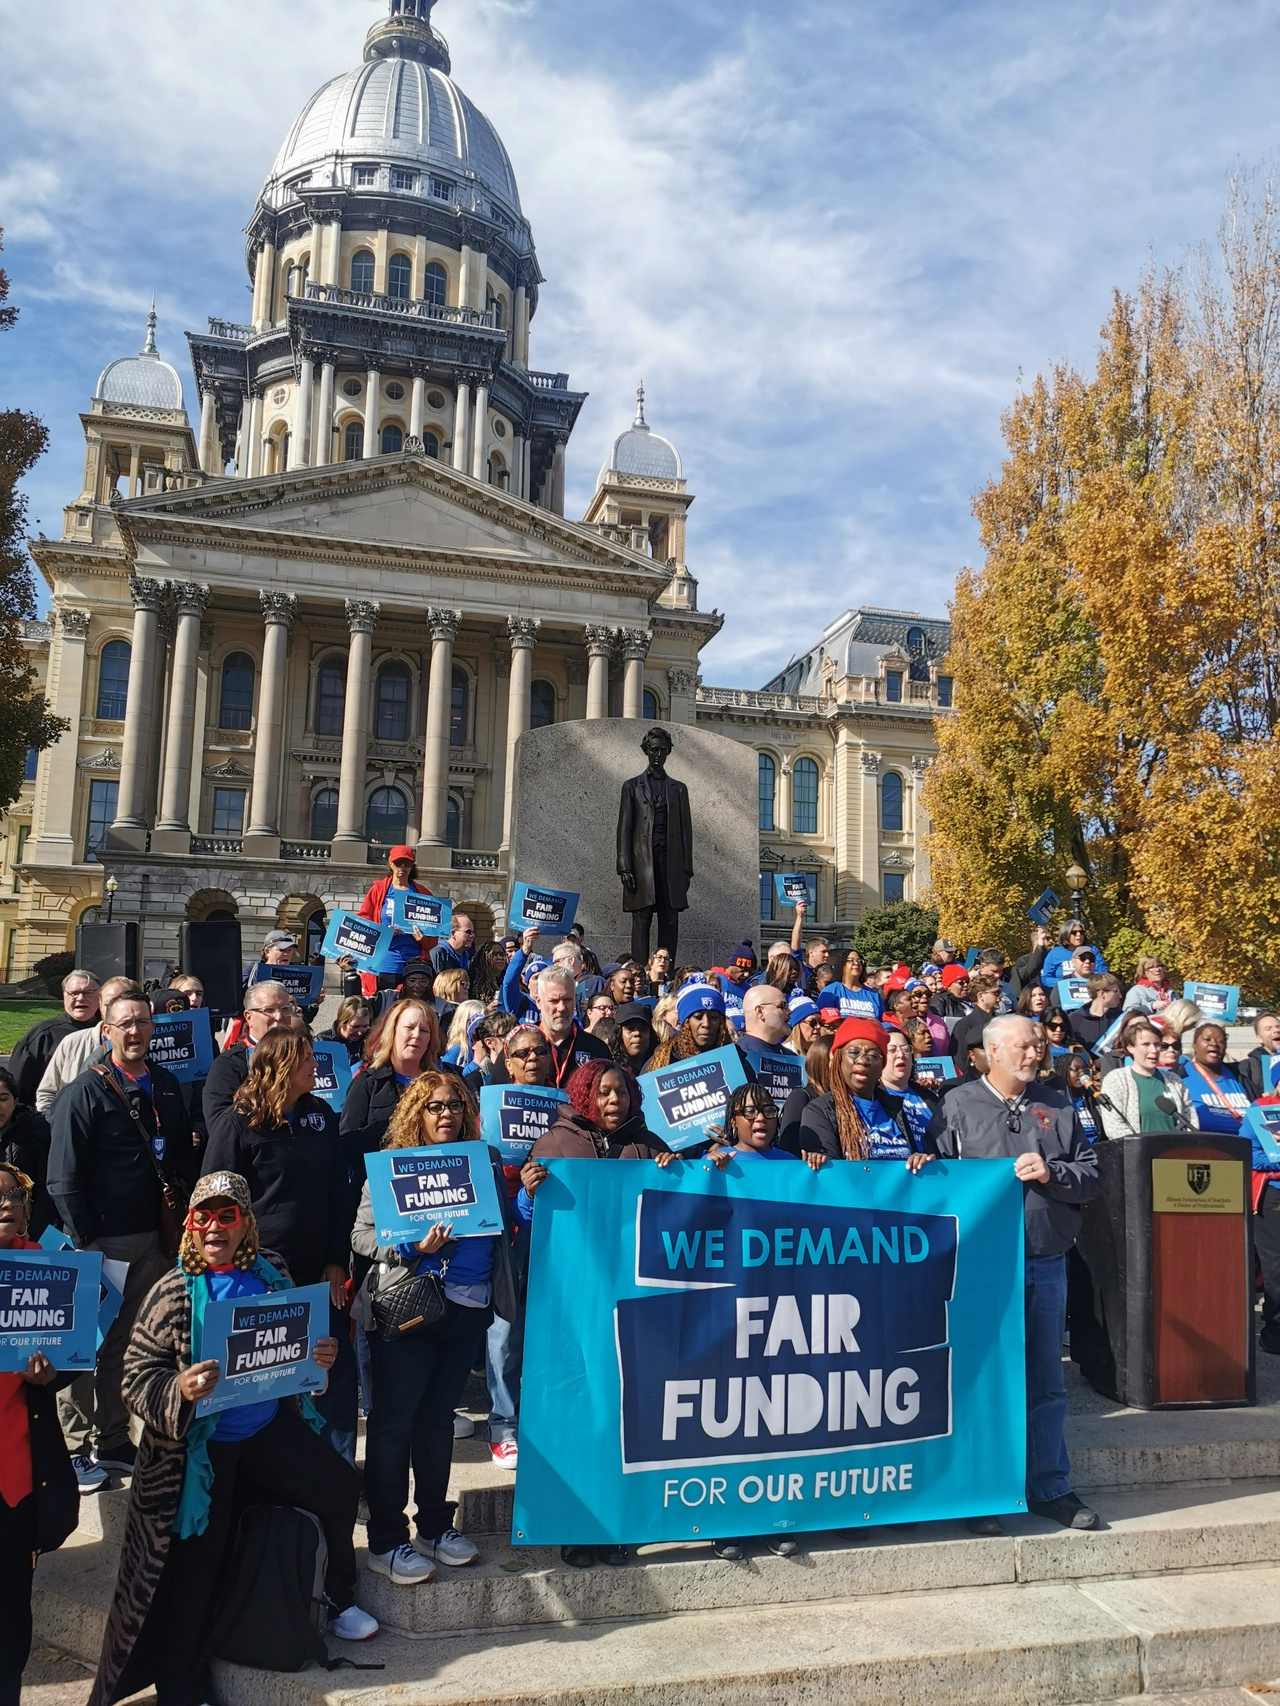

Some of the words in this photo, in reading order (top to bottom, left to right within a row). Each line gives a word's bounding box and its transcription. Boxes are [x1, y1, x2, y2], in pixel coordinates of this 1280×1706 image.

[417, 900, 440, 908] DEMAND
[536, 902, 553, 912] FAIR
[538, 896, 564, 904] DEMAND
[408, 912, 438, 922] FUNDING
[416, 906, 432, 914] FAIR
[526, 909, 560, 920] FUNDING
[344, 921, 354, 929] WE
[354, 924, 378, 936] DEMAND
[350, 930, 366, 942] FAIR
[340, 936, 372, 954] FUNDING
[736, 958, 752, 968] CTU
[840, 998, 874, 1012] ILLINOIS
[1196, 1000, 1224, 1010] FUNDING
[1204, 994, 1218, 1002] FAIR
[152, 1024, 188, 1034] EMAND
[150, 1036, 176, 1050] FAIR
[149, 1048, 188, 1062] NDING
[773, 1064, 798, 1073] DEMAND
[662, 1078, 676, 1090] WE
[677, 1064, 716, 1084] DEMAND
[772, 1074, 788, 1086] FAIR
[680, 1082, 708, 1102] FAIR
[764, 1086, 792, 1098] UNDIN
[508, 1097, 522, 1106] WE
[671, 1092, 726, 1120] FUNDING
[523, 1110, 549, 1126] FAIR
[678, 1122, 692, 1132] FOR
[692, 1116, 708, 1126] OUR
[708, 1110, 726, 1122] FUTUR
[509, 1124, 550, 1138] FUNDI
[398, 1163, 414, 1174] WE
[418, 1158, 463, 1171] DEMAND
[418, 1173, 450, 1190] FAIR
[1188, 1170, 1210, 1182] IFT
[210, 1175, 232, 1193] NY
[404, 1188, 468, 1208] FUNDING
[410, 1214, 425, 1222] FOR
[426, 1212, 442, 1220] OUR
[444, 1208, 470, 1218] FUTURE
[662, 1230, 724, 1270] WE
[742, 1226, 930, 1268] DEMAND
[16, 1270, 70, 1281] DEMAND
[10, 1288, 50, 1306] FAIR
[0, 1310, 66, 1328] UNDING
[238, 1314, 256, 1328] WE
[258, 1306, 304, 1325] DEMAND
[736, 1294, 862, 1359] FAIR
[10, 1338, 30, 1346] OUR
[32, 1336, 62, 1346] FUTURE
[255, 1326, 288, 1348] FAIR
[236, 1344, 301, 1371] FUNDING
[234, 1376, 250, 1386] FOR
[252, 1373, 269, 1382] OUR
[270, 1366, 296, 1378] FUTURE
[662, 1367, 920, 1441] FUNDING
[663, 1478, 726, 1508] FOR
[738, 1475, 804, 1502] OUR
[814, 1464, 913, 1499] FUTURE
